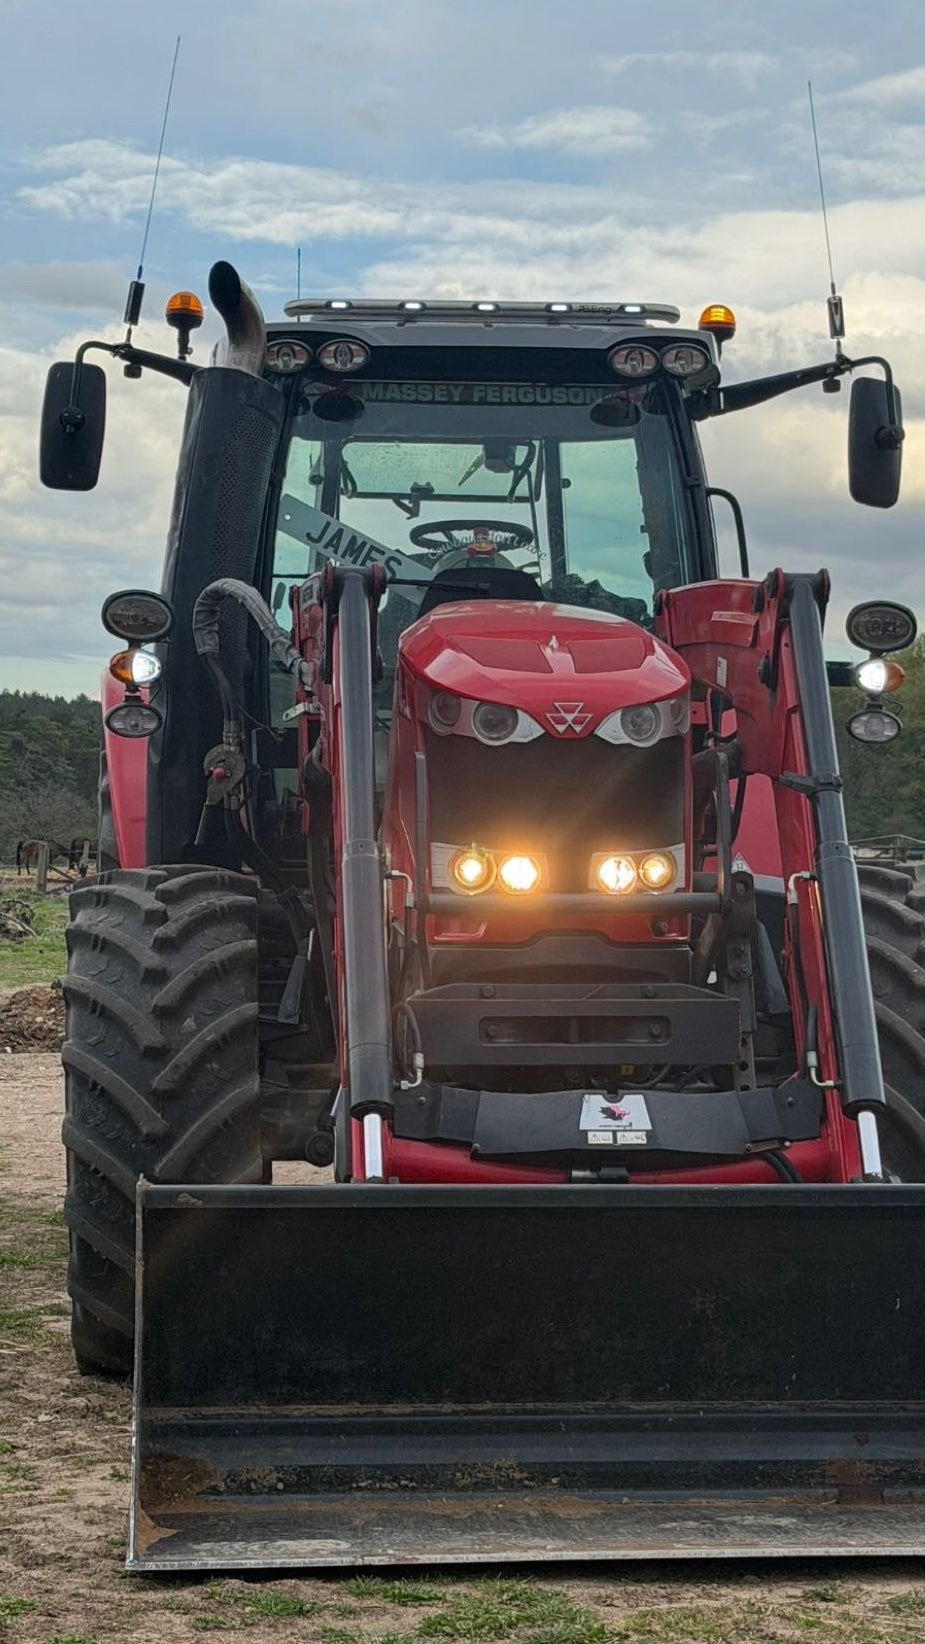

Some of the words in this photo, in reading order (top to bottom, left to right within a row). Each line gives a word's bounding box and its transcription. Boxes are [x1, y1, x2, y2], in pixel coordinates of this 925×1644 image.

[362, 383, 463, 401] MASSEY
[473, 386, 603, 404] FERGUSON
[306, 521, 402, 580] JAMES
